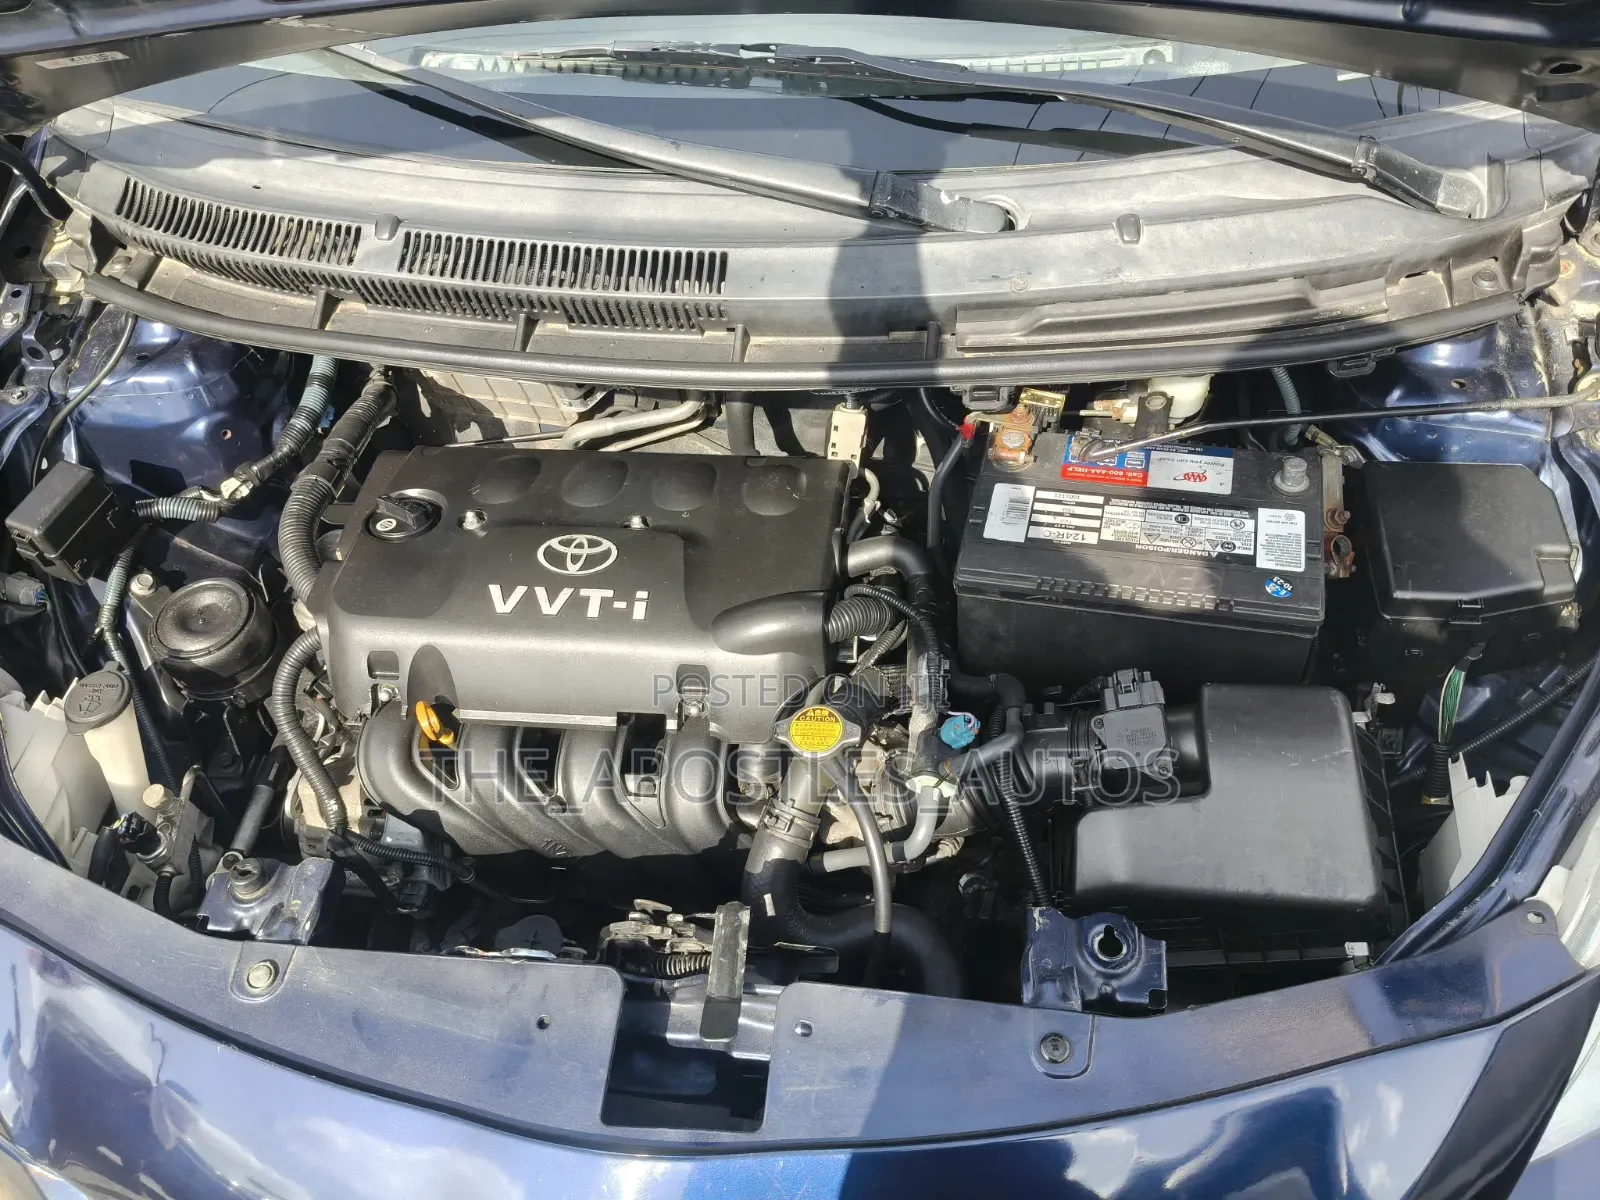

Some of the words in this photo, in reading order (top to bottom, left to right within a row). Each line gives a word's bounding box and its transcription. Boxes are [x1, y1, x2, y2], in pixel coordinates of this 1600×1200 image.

[1183, 472, 1207, 482] AAA
[1044, 530, 1087, 541] 124R-C
[1135, 544, 1209, 556] DANGER/POISON
[1272, 576, 1294, 591] 10-23
[488, 584, 649, 620] VVT-i
